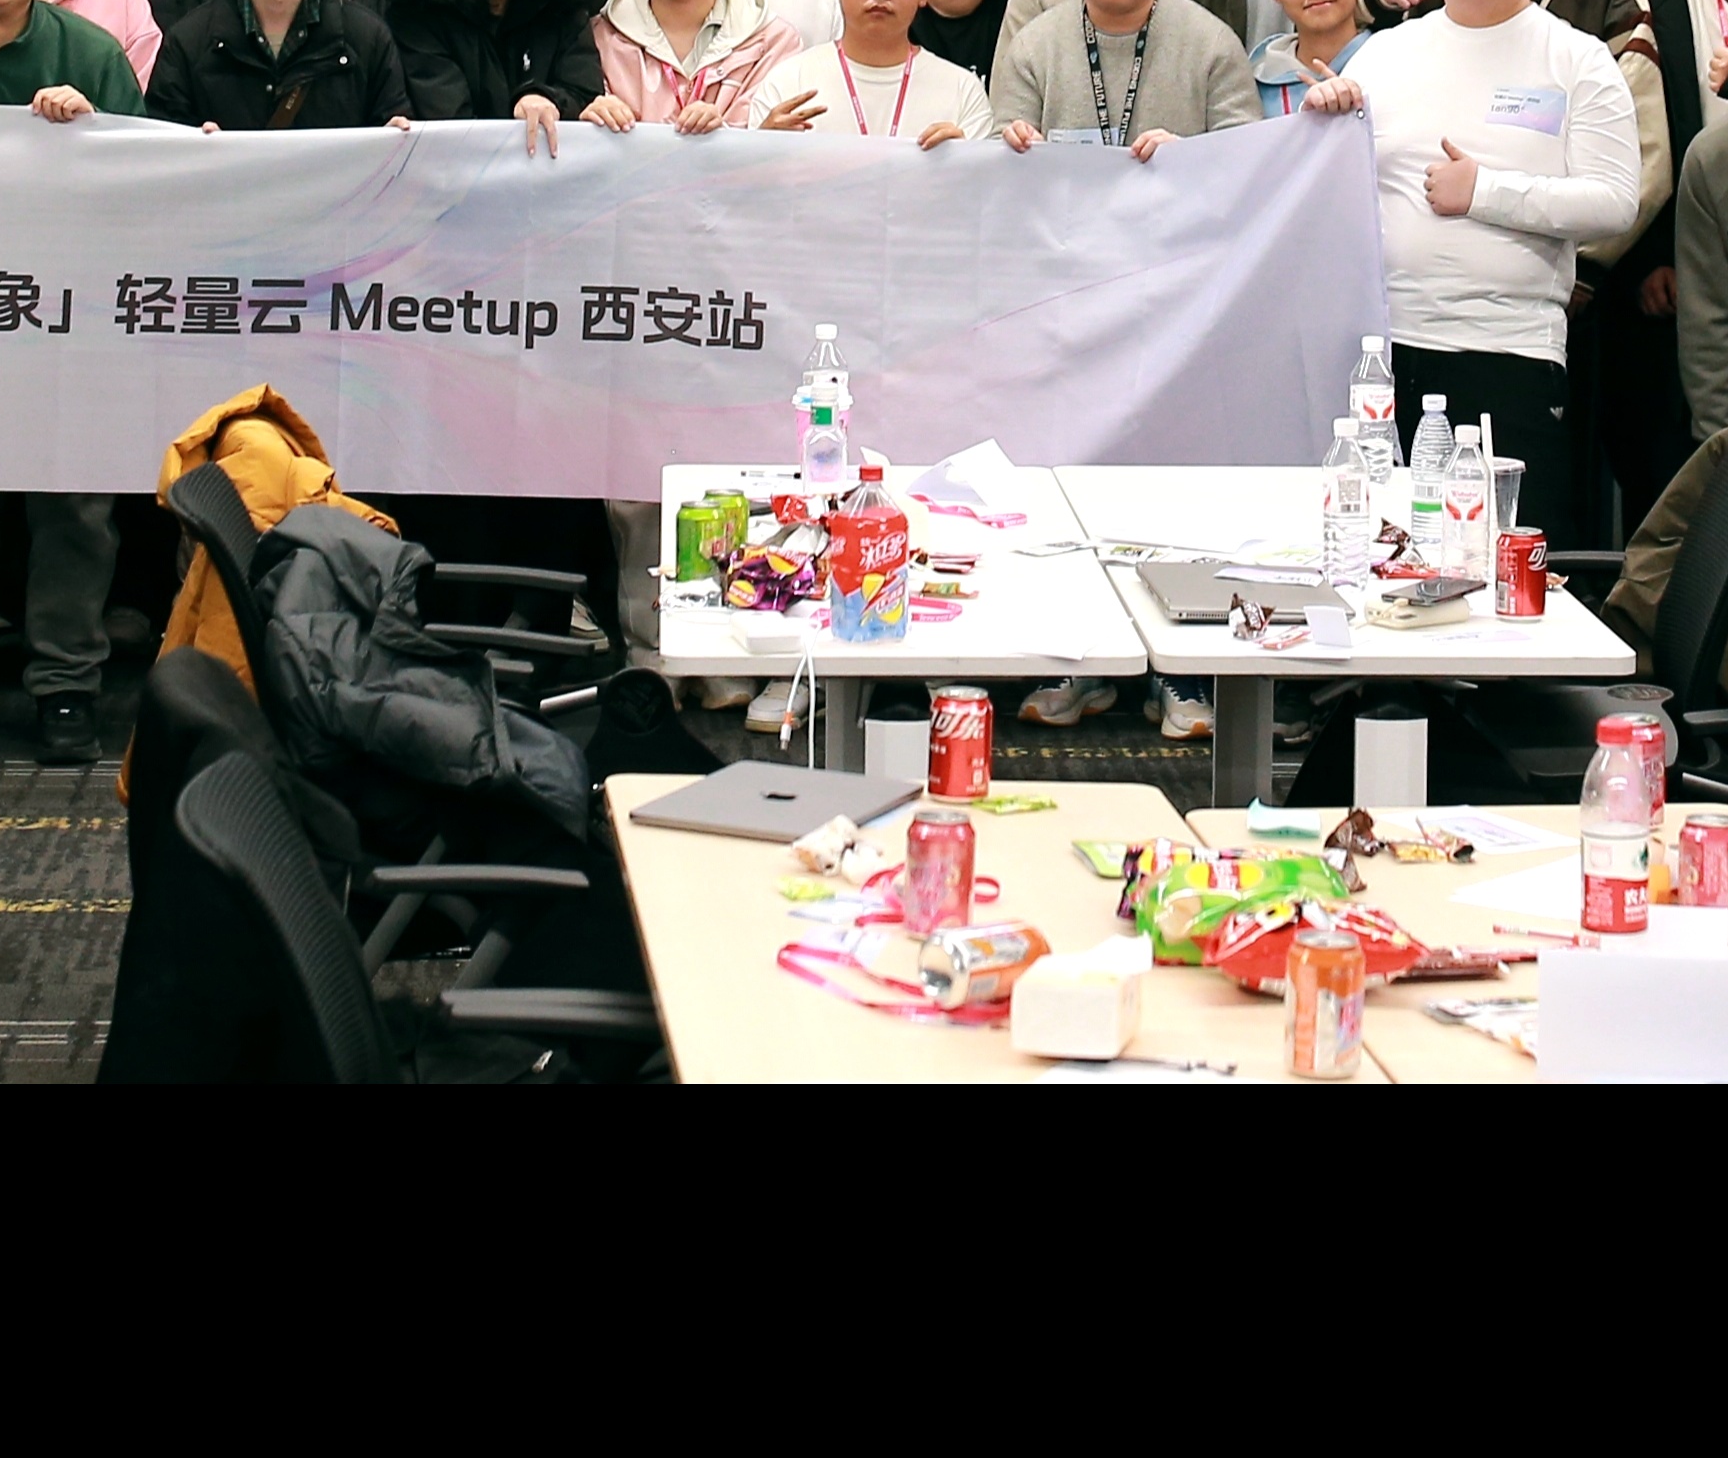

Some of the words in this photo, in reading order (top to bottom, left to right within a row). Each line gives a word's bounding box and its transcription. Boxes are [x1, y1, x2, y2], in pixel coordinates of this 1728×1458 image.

[1091, 70, 1106, 107] FUTURE
[114, 273, 308, 335] 轻量云
[330, 282, 558, 350] Meetup
[580, 285, 767, 351] 西安站
